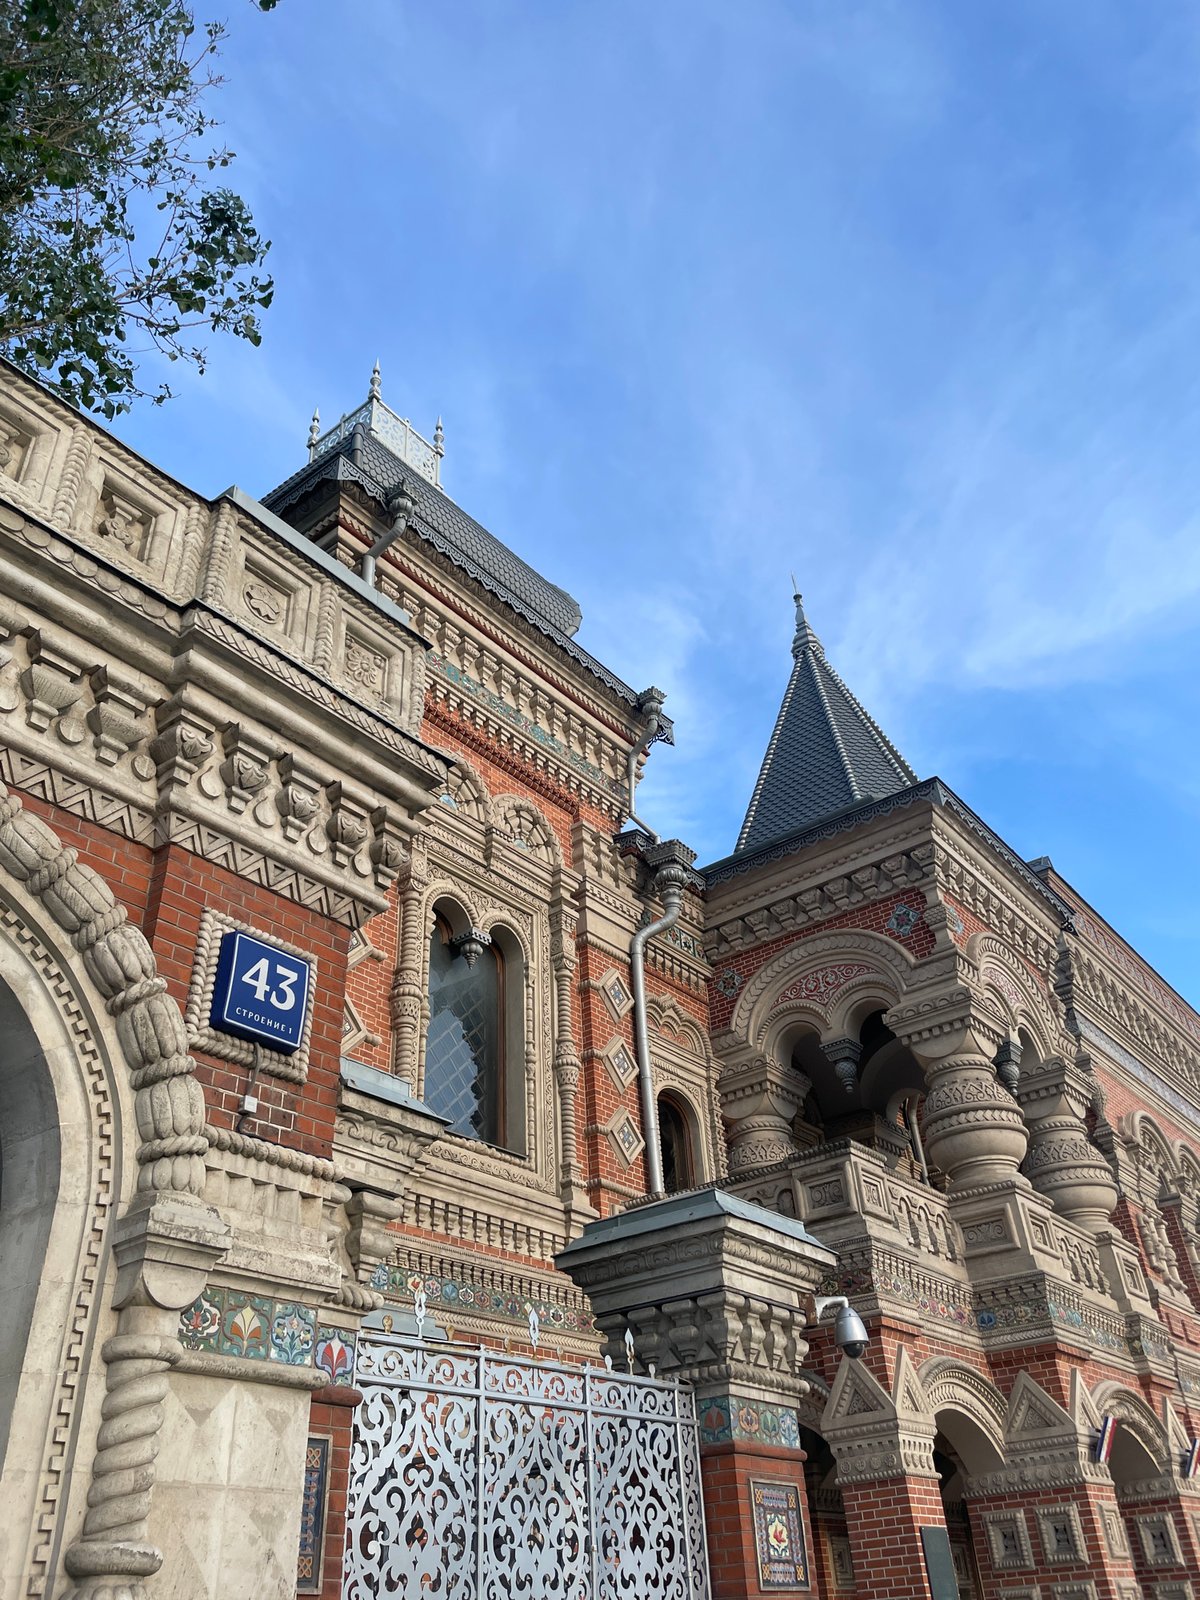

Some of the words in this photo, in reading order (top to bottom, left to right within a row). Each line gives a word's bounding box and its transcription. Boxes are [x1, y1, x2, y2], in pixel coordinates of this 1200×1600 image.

[241, 957, 298, 1011] 43
[235, 1007, 287, 1032] СТРОЕНИЕ
[288, 1027, 293, 1035] 1
